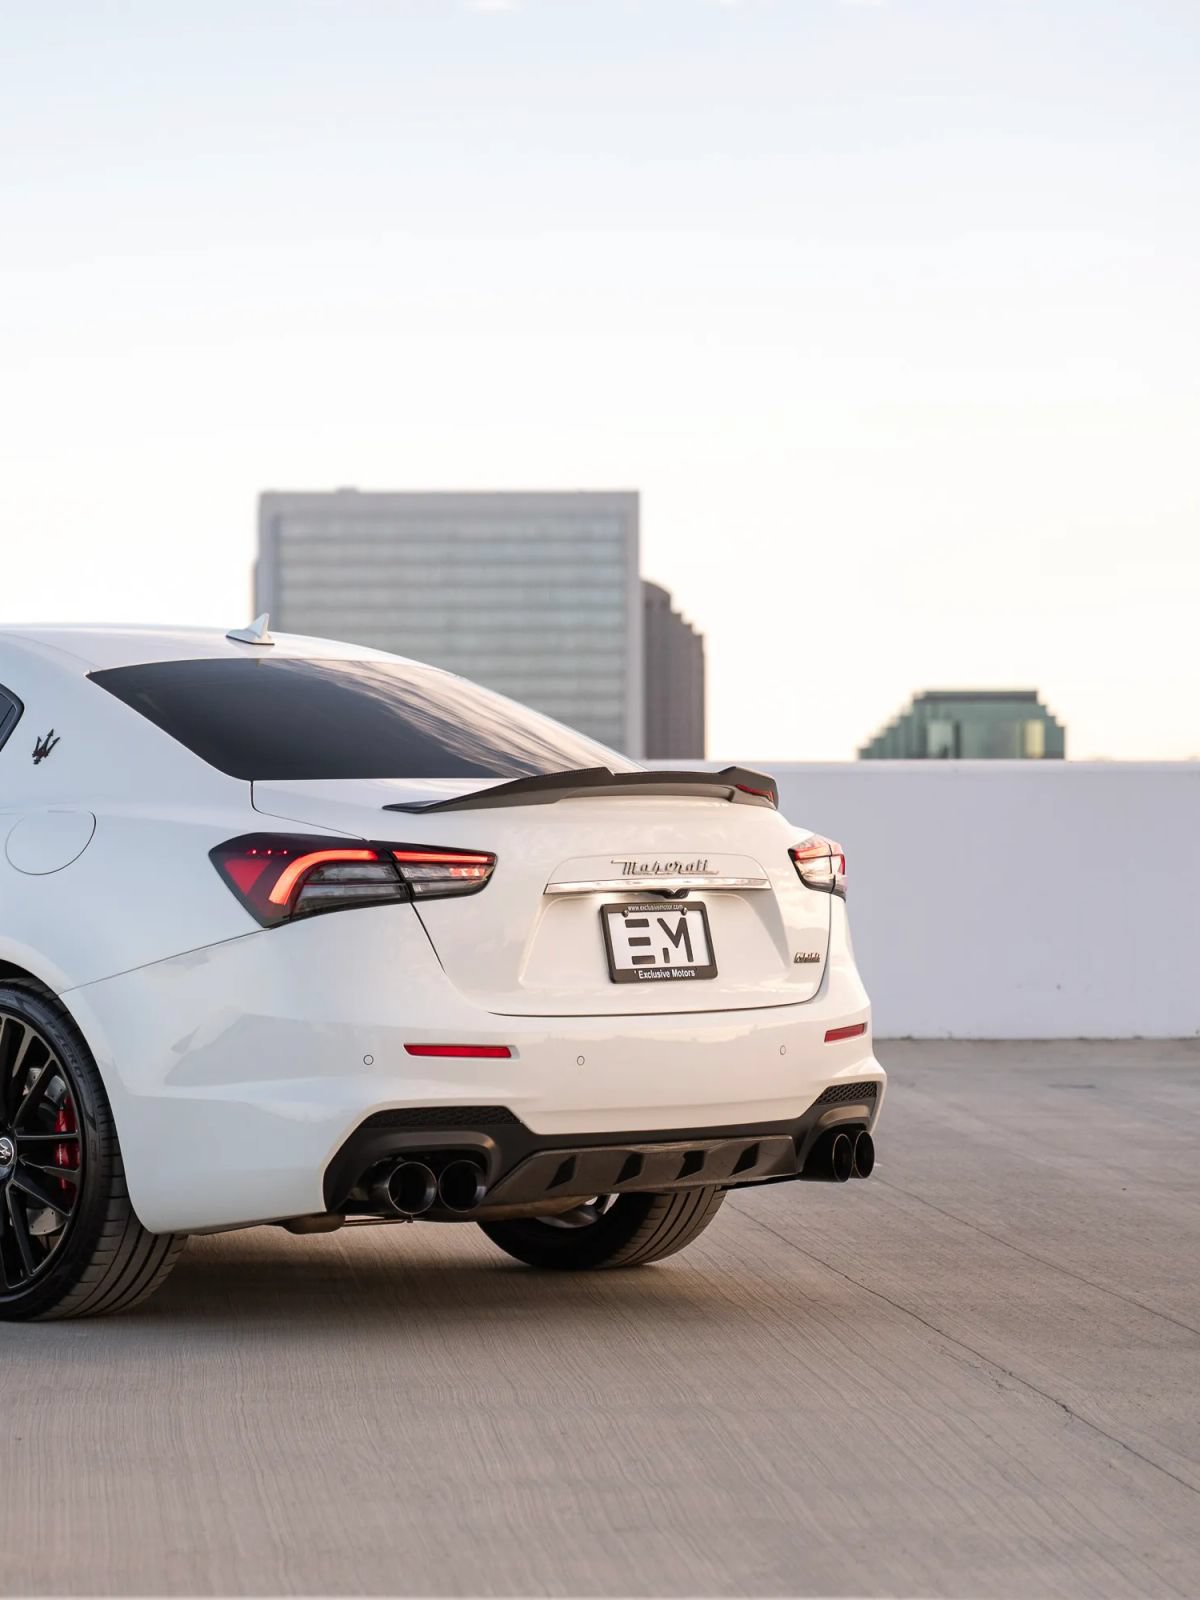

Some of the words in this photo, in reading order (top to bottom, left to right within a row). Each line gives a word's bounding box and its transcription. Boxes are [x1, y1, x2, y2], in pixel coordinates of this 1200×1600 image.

[611, 858, 719, 876] Maserati
[628, 903, 683, 912] www.exclusivemotor.com
[625, 917, 694, 965] EM
[638, 969, 670, 979] Exclusive
[671, 968, 696, 978] Motors
